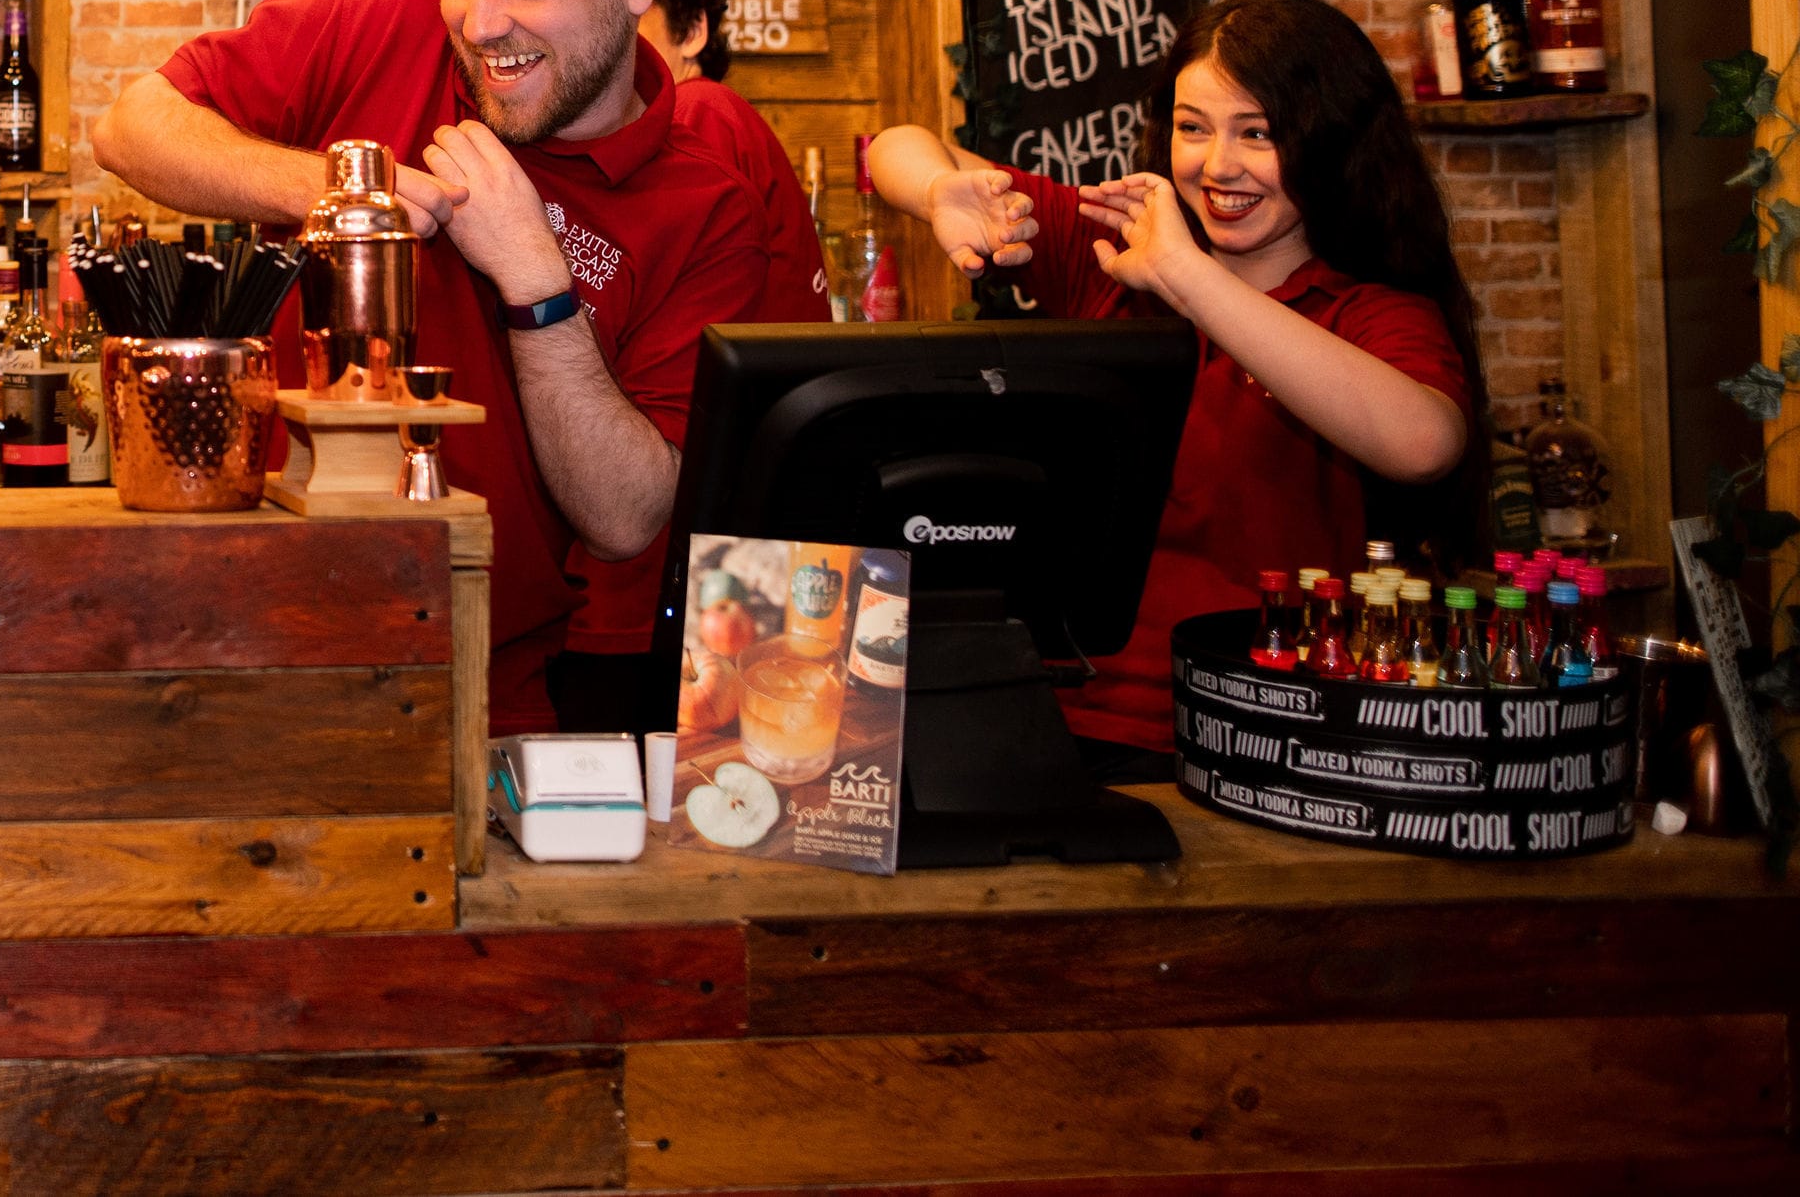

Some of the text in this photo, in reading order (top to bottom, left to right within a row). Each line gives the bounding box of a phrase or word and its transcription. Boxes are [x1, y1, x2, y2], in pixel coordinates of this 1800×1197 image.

[1008, 12, 1179, 92] ICED TEA
[561, 238, 617, 280] ESCAPE
[567, 224, 622, 264] EXITUS
[565, 258, 606, 290] OOMS
[903, 515, 1016, 545] eposnow
[1192, 668, 1307, 711] MIXED VODKA SHOTS
[1195, 711, 1234, 757] SHOT
[1421, 698, 1559, 738] COOL SHOT
[1299, 748, 1467, 784] MIXED VODKA SHOTS
[1550, 753, 1595, 793] COOL
[829, 778, 891, 803] BARTI
[1219, 779, 1358, 827] MIXED VODKA SHOTS
[1451, 812, 1516, 851] COOL
[1528, 811, 1581, 851] SHOT
